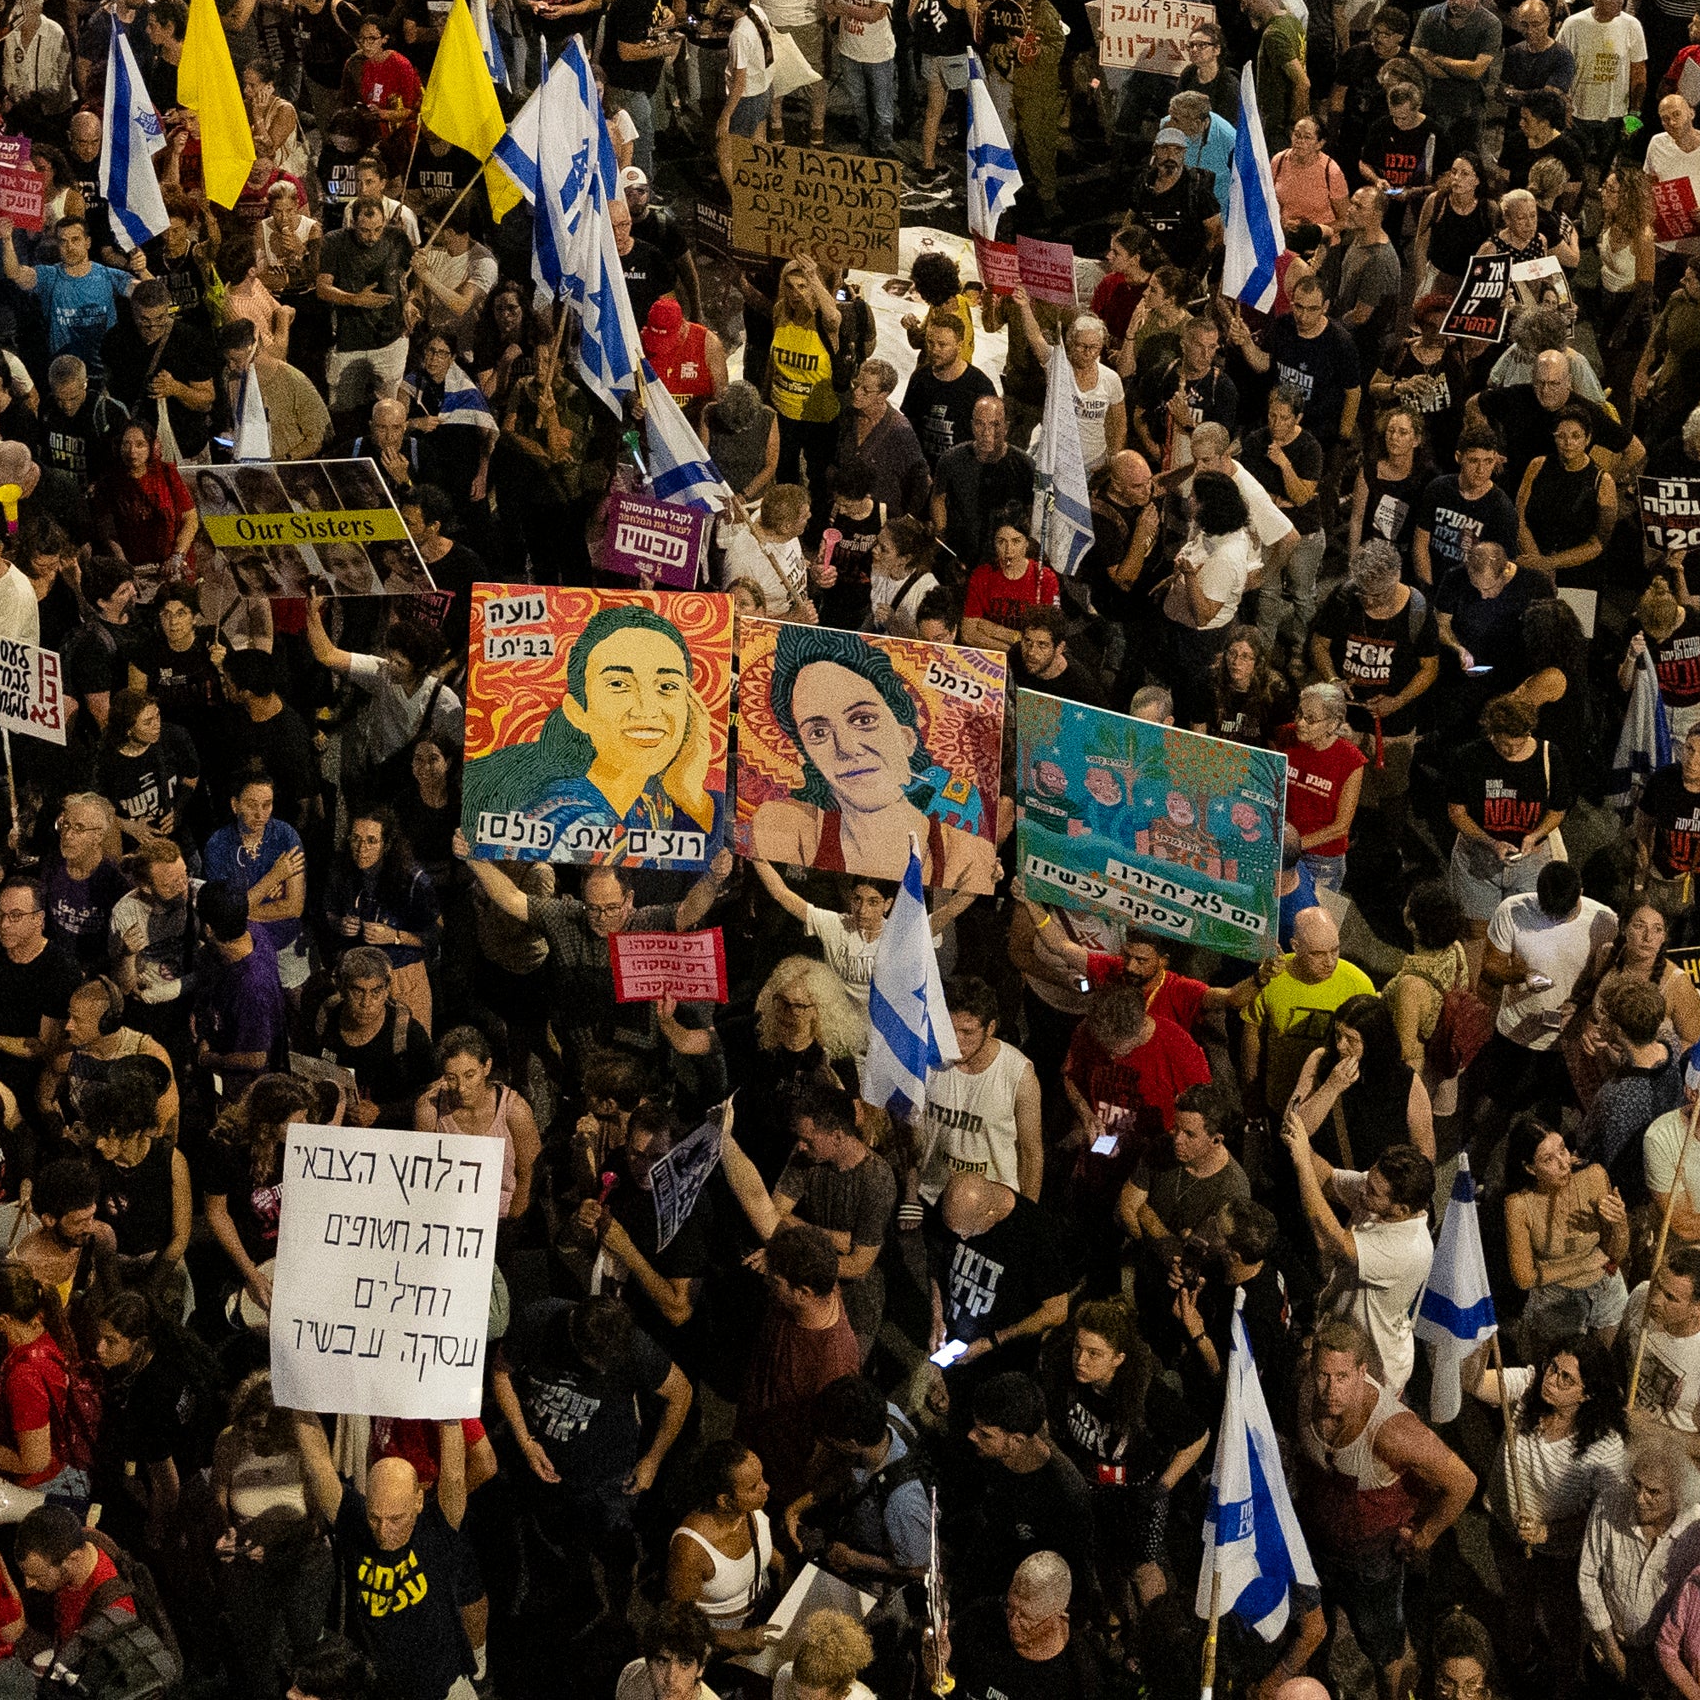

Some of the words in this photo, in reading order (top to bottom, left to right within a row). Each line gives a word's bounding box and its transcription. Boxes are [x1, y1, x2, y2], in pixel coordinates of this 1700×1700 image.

[1111, 4, 1159, 25] זועק
[743, 144, 785, 171] את
[800, 150, 899, 184] תאהבו
[733, 169, 785, 192] שלכם
[748, 194, 831, 219] שאתם
[794, 184, 899, 212] האזרחים
[756, 218, 798, 236] את
[848, 205, 898, 230] כמו
[809, 224, 894, 252] אוהבים
[1489, 262, 1506, 281] אל
[1471, 282, 1505, 299] תתנו
[1462, 299, 1481, 315] לו
[1449, 314, 1498, 334] להקריב
[1658, 481, 1689, 499] רק
[619, 513, 651, 528] המלחמה
[620, 500, 652, 517] העסקה
[653, 509, 668, 519] את
[669, 511, 694, 525] לקבל
[235, 517, 284, 542] Our
[289, 515, 376, 539] Sisters
[652, 522, 667, 530] את
[622, 528, 684, 562] עכשיו
[489, 599, 546, 624] נועה
[487, 635, 555, 659] בבית!
[1345, 640, 1395, 666] FCK
[1342, 658, 1391, 679] BNGVR
[929, 662, 984, 701] כרמל
[29, 705, 60, 731] לא
[1485, 779, 1504, 790] BRING
[1484, 799, 1541, 828] NOW!
[477, 812, 552, 849] כולם!
[568, 826, 614, 851] את
[629, 827, 704, 859] רוצים
[1029, 856, 1109, 901] עכשיו!
[1111, 861, 1186, 900] יחזרו.
[1118, 895, 1189, 931] עסקה
[1195, 890, 1222, 914] לא
[1231, 908, 1261, 930] הם
[629, 939, 679, 951] עסקה!
[683, 940, 704, 952] רק
[632, 959, 682, 972] עסקה!
[685, 961, 707, 973] רק
[688, 981, 710, 994] רק
[293, 1144, 376, 1186] הצבאי
[394, 1139, 481, 1205] הלחץ
[322, 1210, 411, 1249] חטופים
[417, 1220, 484, 1261] הורג
[354, 1261, 453, 1318] וחילים
[399, 1332, 478, 1384] עסקה
